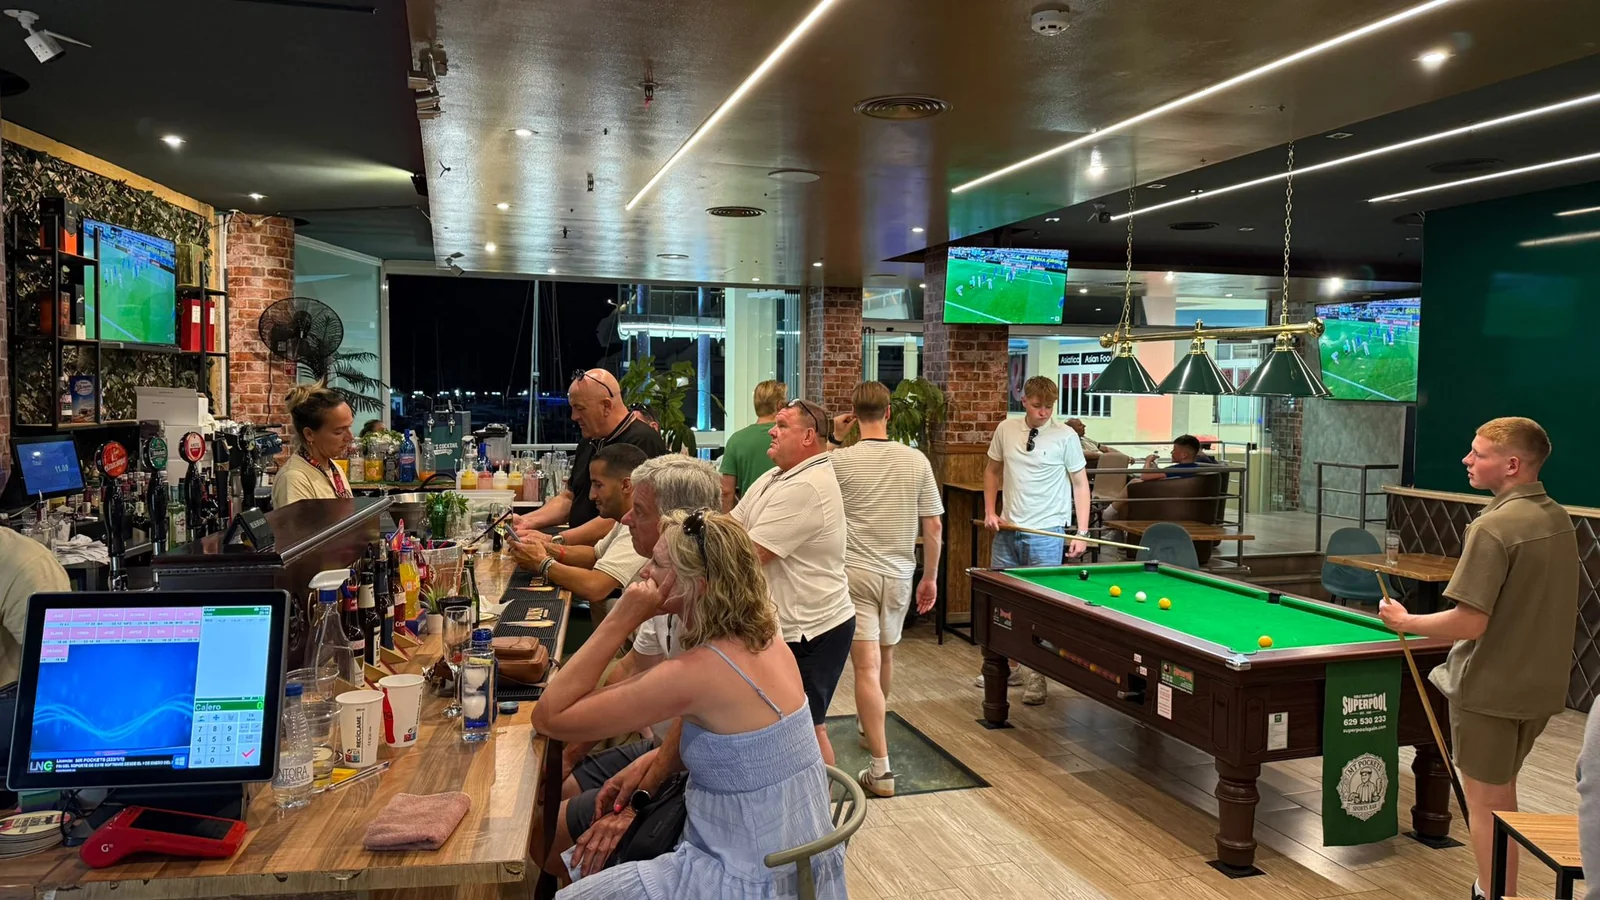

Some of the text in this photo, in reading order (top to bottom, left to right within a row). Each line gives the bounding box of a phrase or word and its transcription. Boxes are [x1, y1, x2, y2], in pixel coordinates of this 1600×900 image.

[1084, 354, 1111, 364] Asian Foo
[1342, 692, 1387, 716] SUPERPOOL
[1343, 715, 1387, 726] 629 530 233
[1357, 760, 1382, 771] POCKETS
